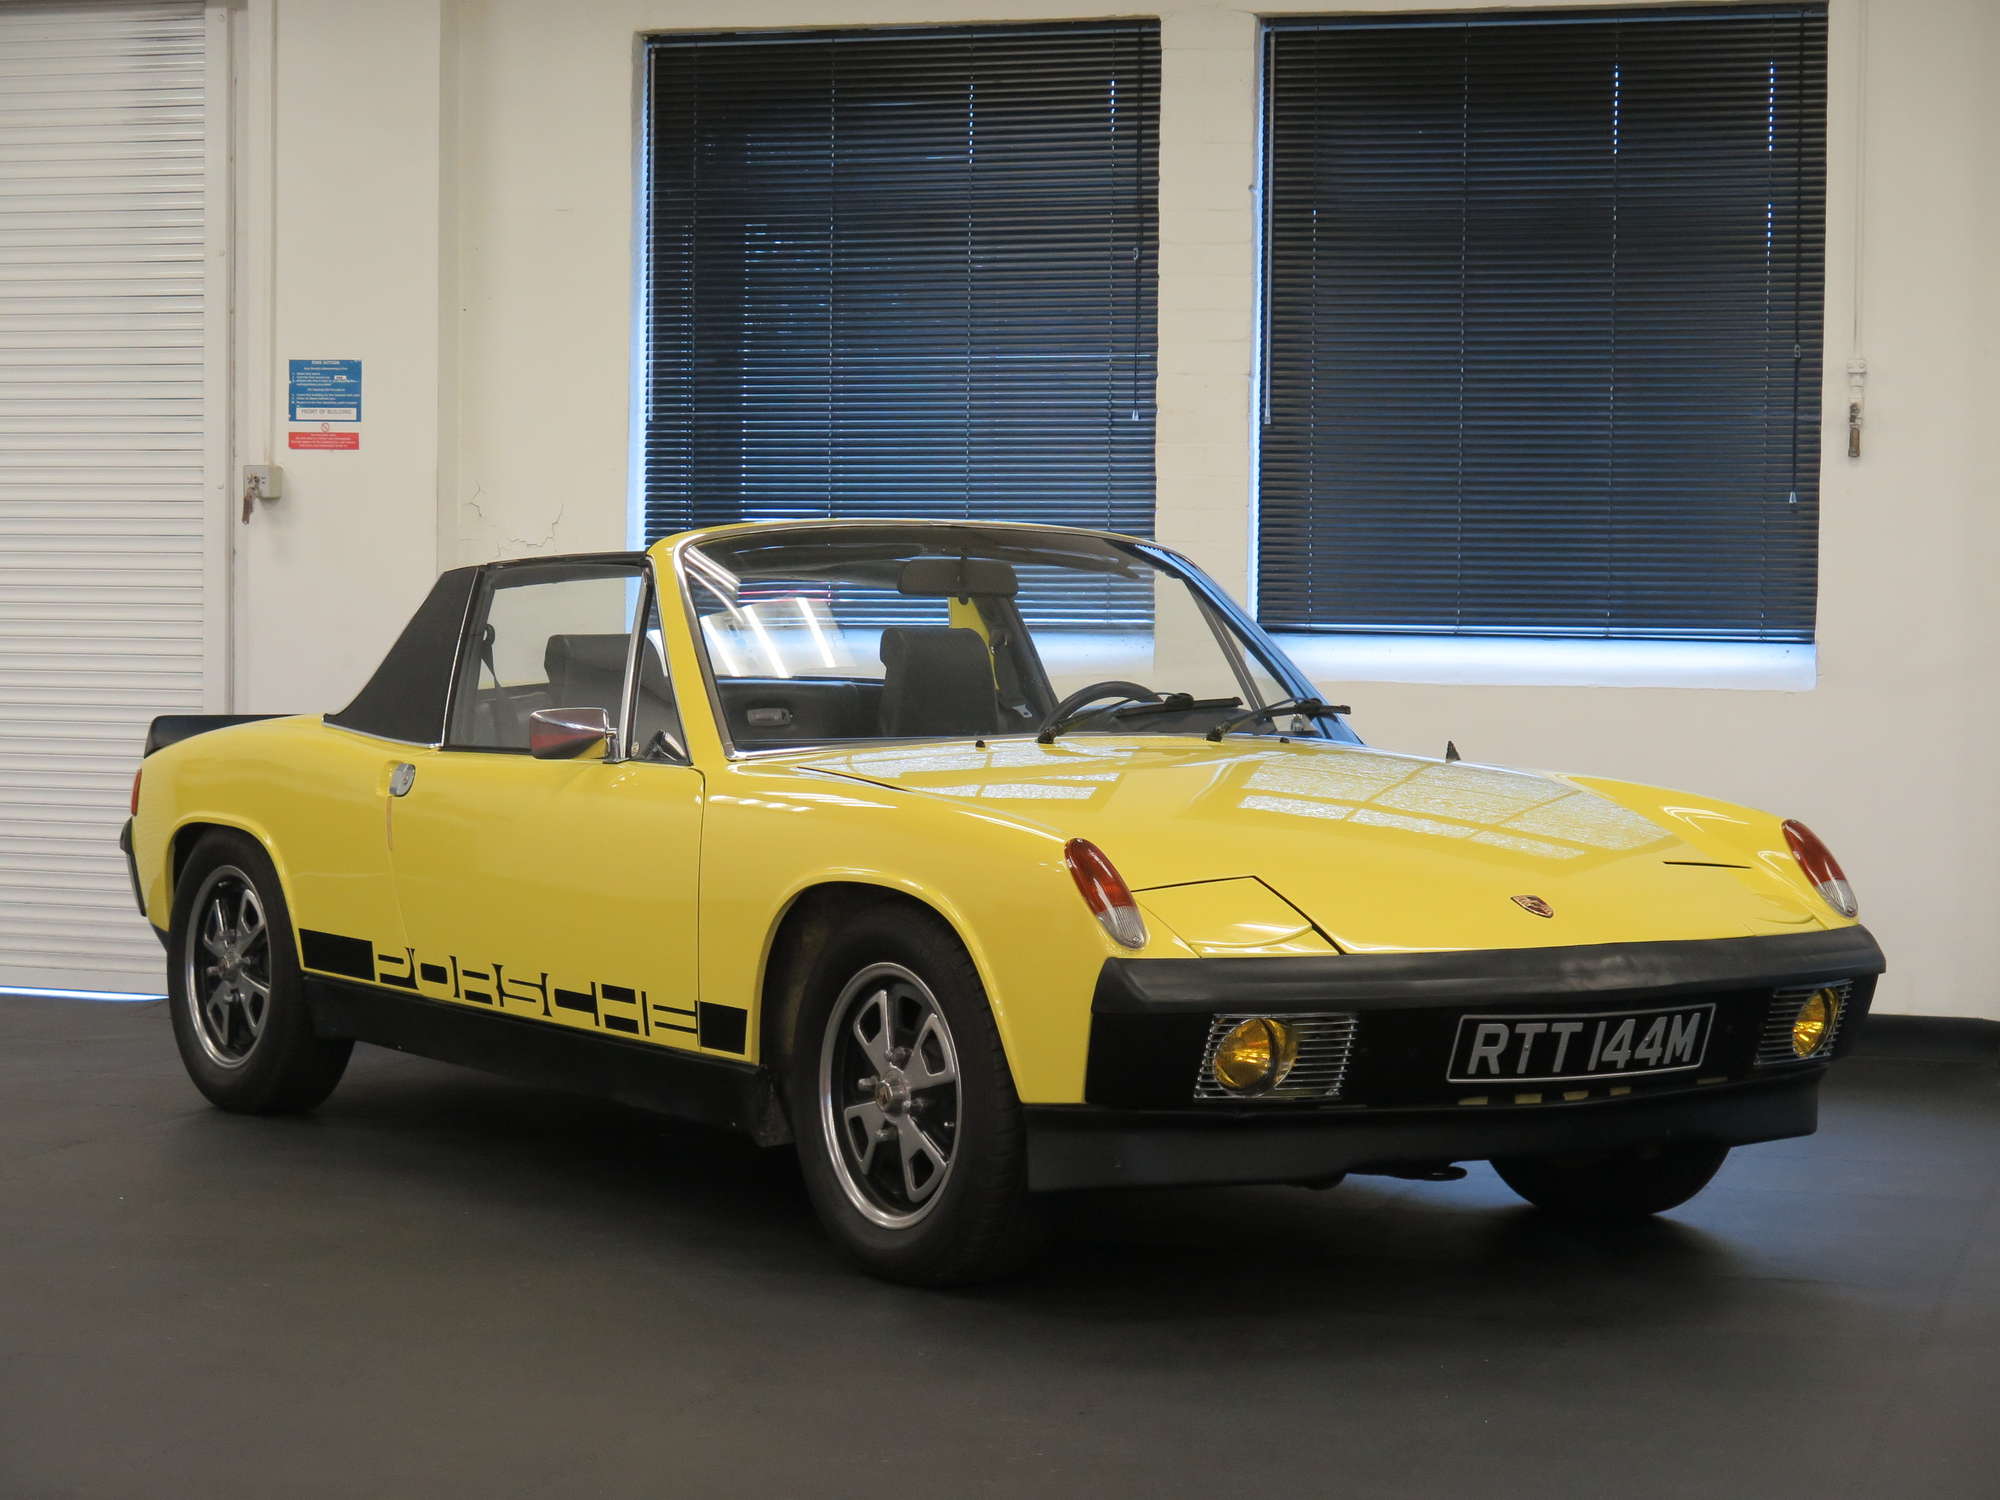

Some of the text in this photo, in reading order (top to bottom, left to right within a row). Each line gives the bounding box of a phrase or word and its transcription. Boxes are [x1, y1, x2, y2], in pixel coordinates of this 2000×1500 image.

[376, 945, 699, 1046] PORSCHE
[1467, 1012, 1701, 1075] RTT 144M
